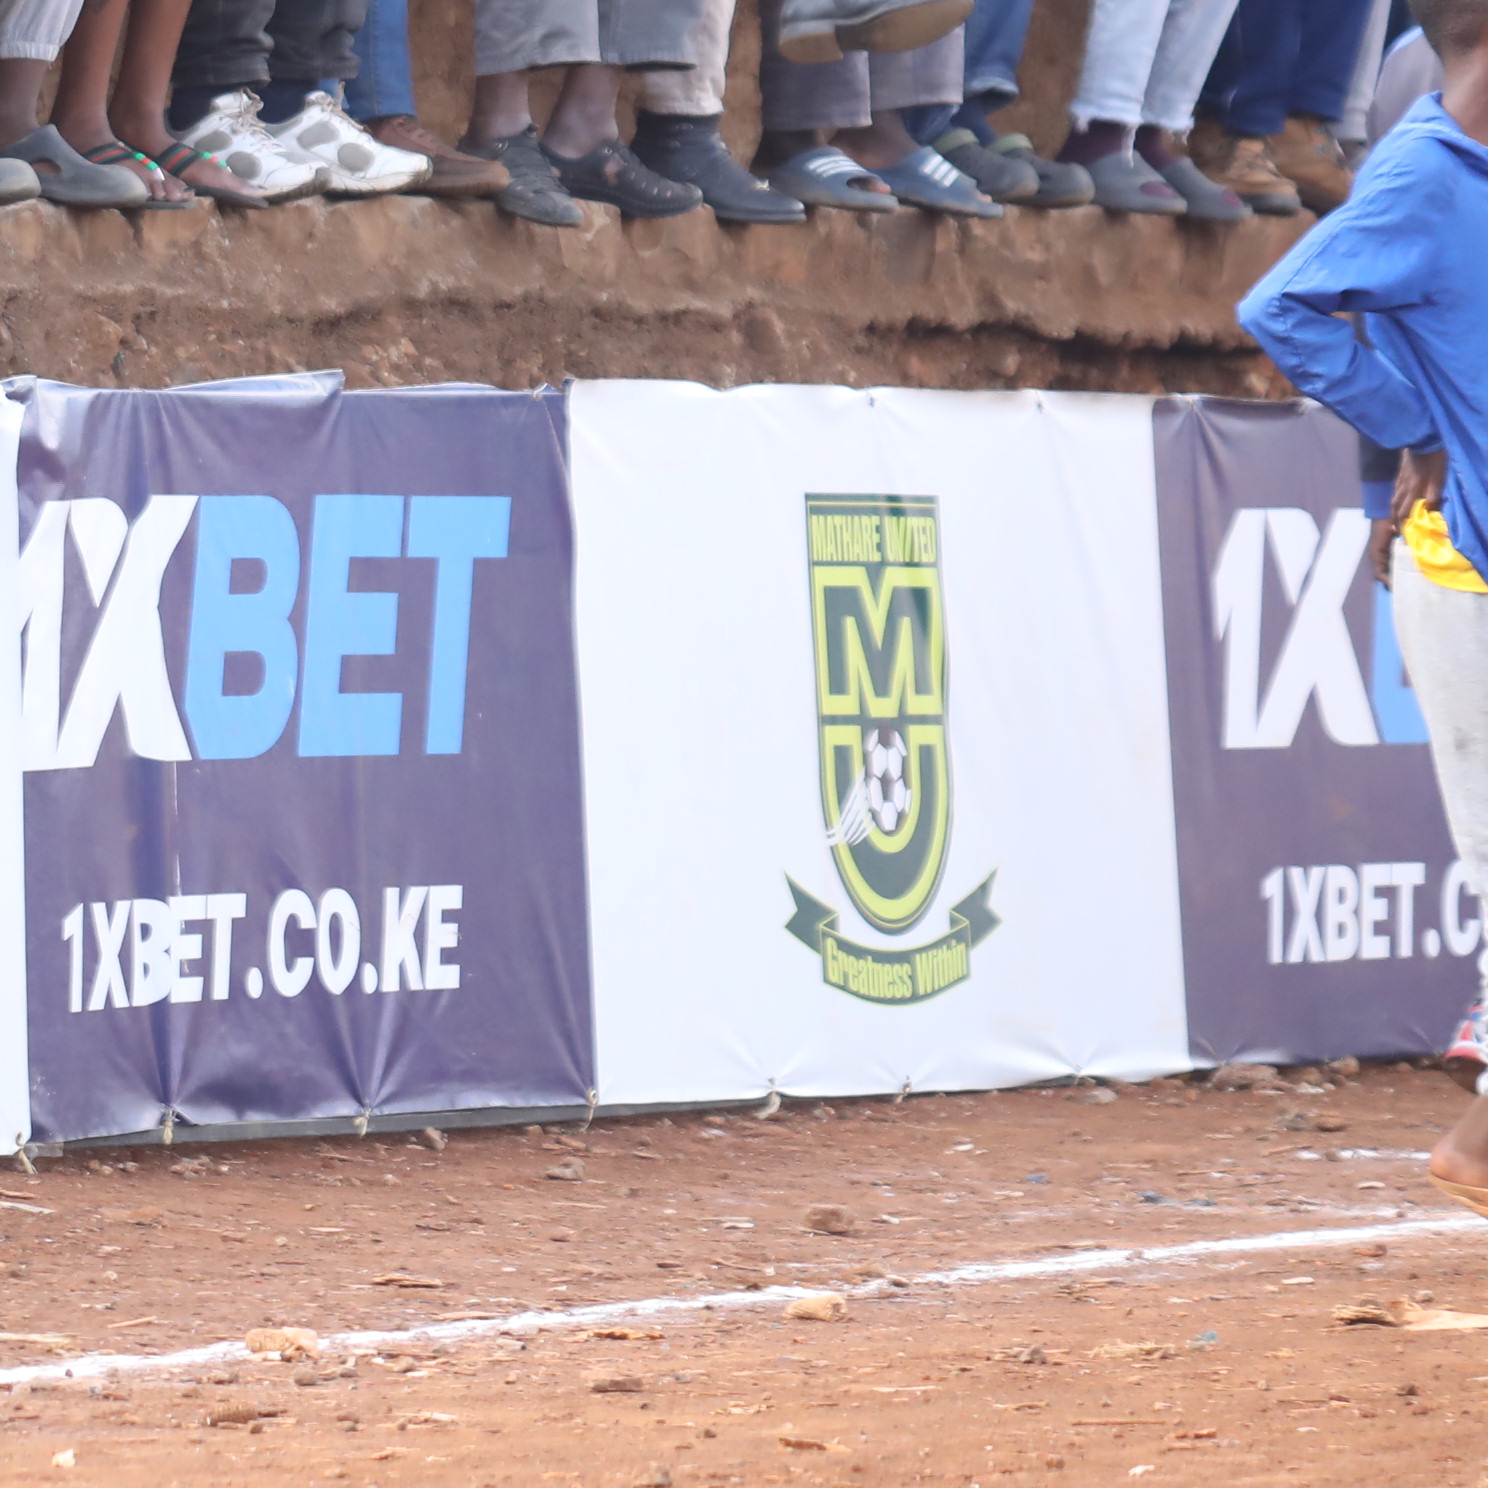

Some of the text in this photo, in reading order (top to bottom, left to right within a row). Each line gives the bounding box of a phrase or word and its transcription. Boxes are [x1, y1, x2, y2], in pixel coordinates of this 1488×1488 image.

[811, 514, 936, 563] MATHARE UNITED
[18, 493, 512, 773] 1XBET
[61, 883, 464, 1013] 1XBET.CO.KE
[825, 935, 969, 1000] Greatness Within
